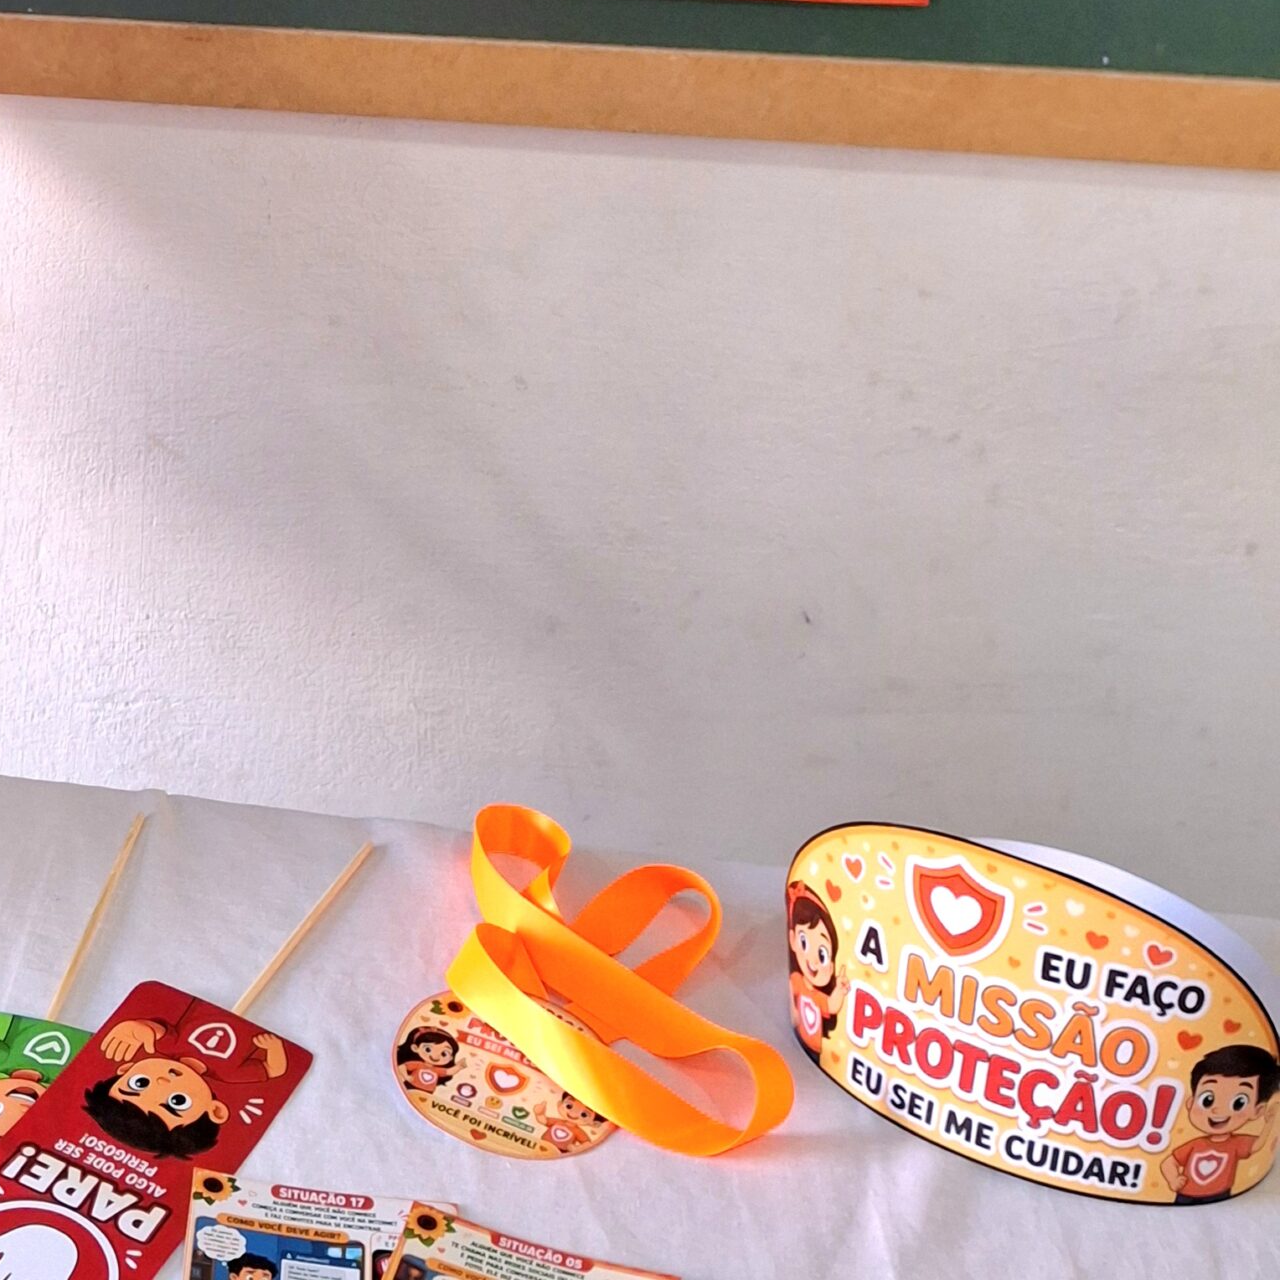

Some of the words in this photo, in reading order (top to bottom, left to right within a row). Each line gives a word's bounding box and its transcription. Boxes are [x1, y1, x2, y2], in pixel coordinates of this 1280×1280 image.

[860, 926, 885, 965] A
[903, 953, 1150, 1078] MISSÃO
[1040, 951, 1092, 990] EU
[1104, 968, 1205, 1017] FAÇO
[851, 988, 1177, 1146] PROTEÇÃO!
[431, 1100, 461, 1118] VOCÊ
[463, 1113, 482, 1128] FOI
[484, 1123, 538, 1150] INCRÍVEL!
[850, 1057, 883, 1096] EU
[890, 1083, 934, 1125] SEI
[944, 1108, 992, 1151] ME
[1004, 1133, 1143, 1189] CUIDAR!
[54, 1138, 84, 1159] SER
[78, 1132, 158, 1177] PERIGOSO!
[83, 1152, 126, 1179] PODE
[0, 1145, 168, 1243] PARE!
[125, 1174, 167, 1198] ALGO
[279, 1187, 346, 1207] SITUAÇÃO
[350, 1197, 366, 1208] 17
[258, 1220, 283, 1233] VOCÊ
[286, 1225, 310, 1237] DEVE
[499, 1237, 563, 1264] SITUAÇÃO
[565, 1257, 583, 1269] 05
